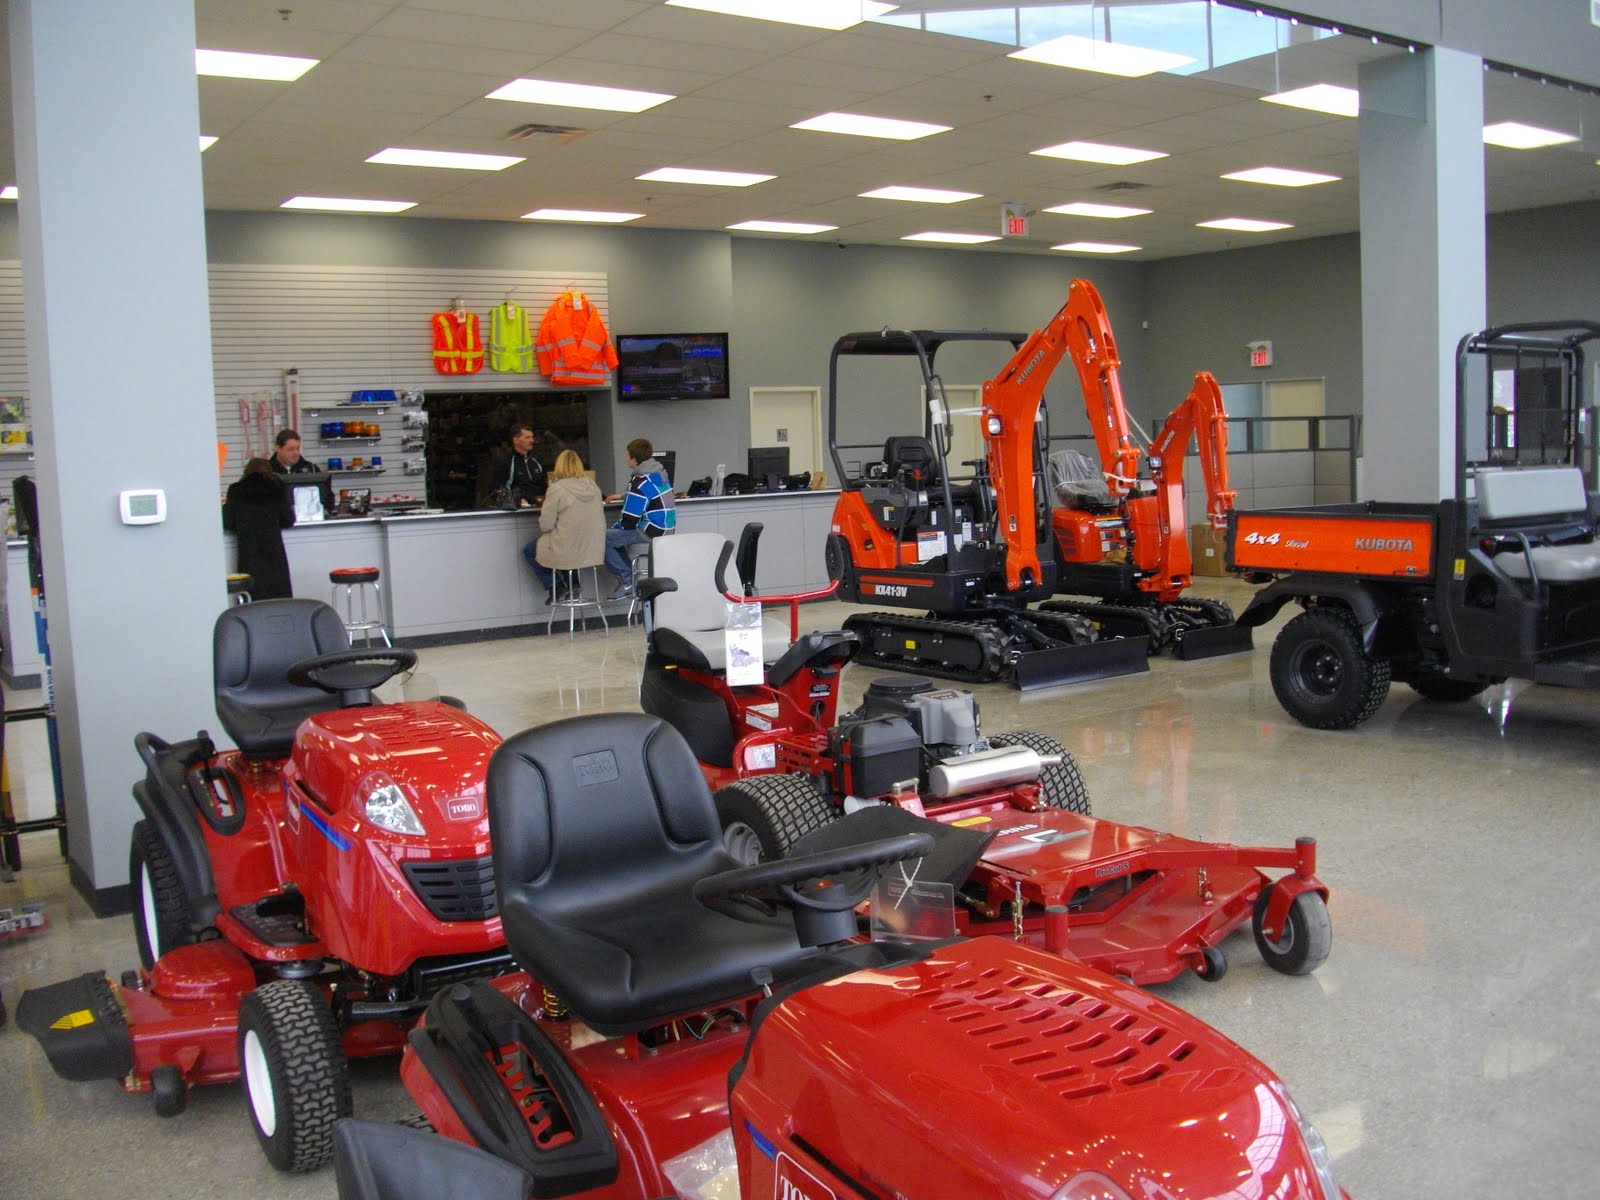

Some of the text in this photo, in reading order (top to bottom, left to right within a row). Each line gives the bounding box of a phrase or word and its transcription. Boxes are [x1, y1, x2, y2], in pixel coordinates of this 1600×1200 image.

[1008, 218, 1025, 235] EXIT
[1016, 349, 1046, 385] KUBOTA
[1244, 532, 1281, 546] 4x4
[1355, 537, 1414, 552] KUBOTA
[875, 584, 908, 598] KX41-3V
[450, 804, 476, 813] TORO
